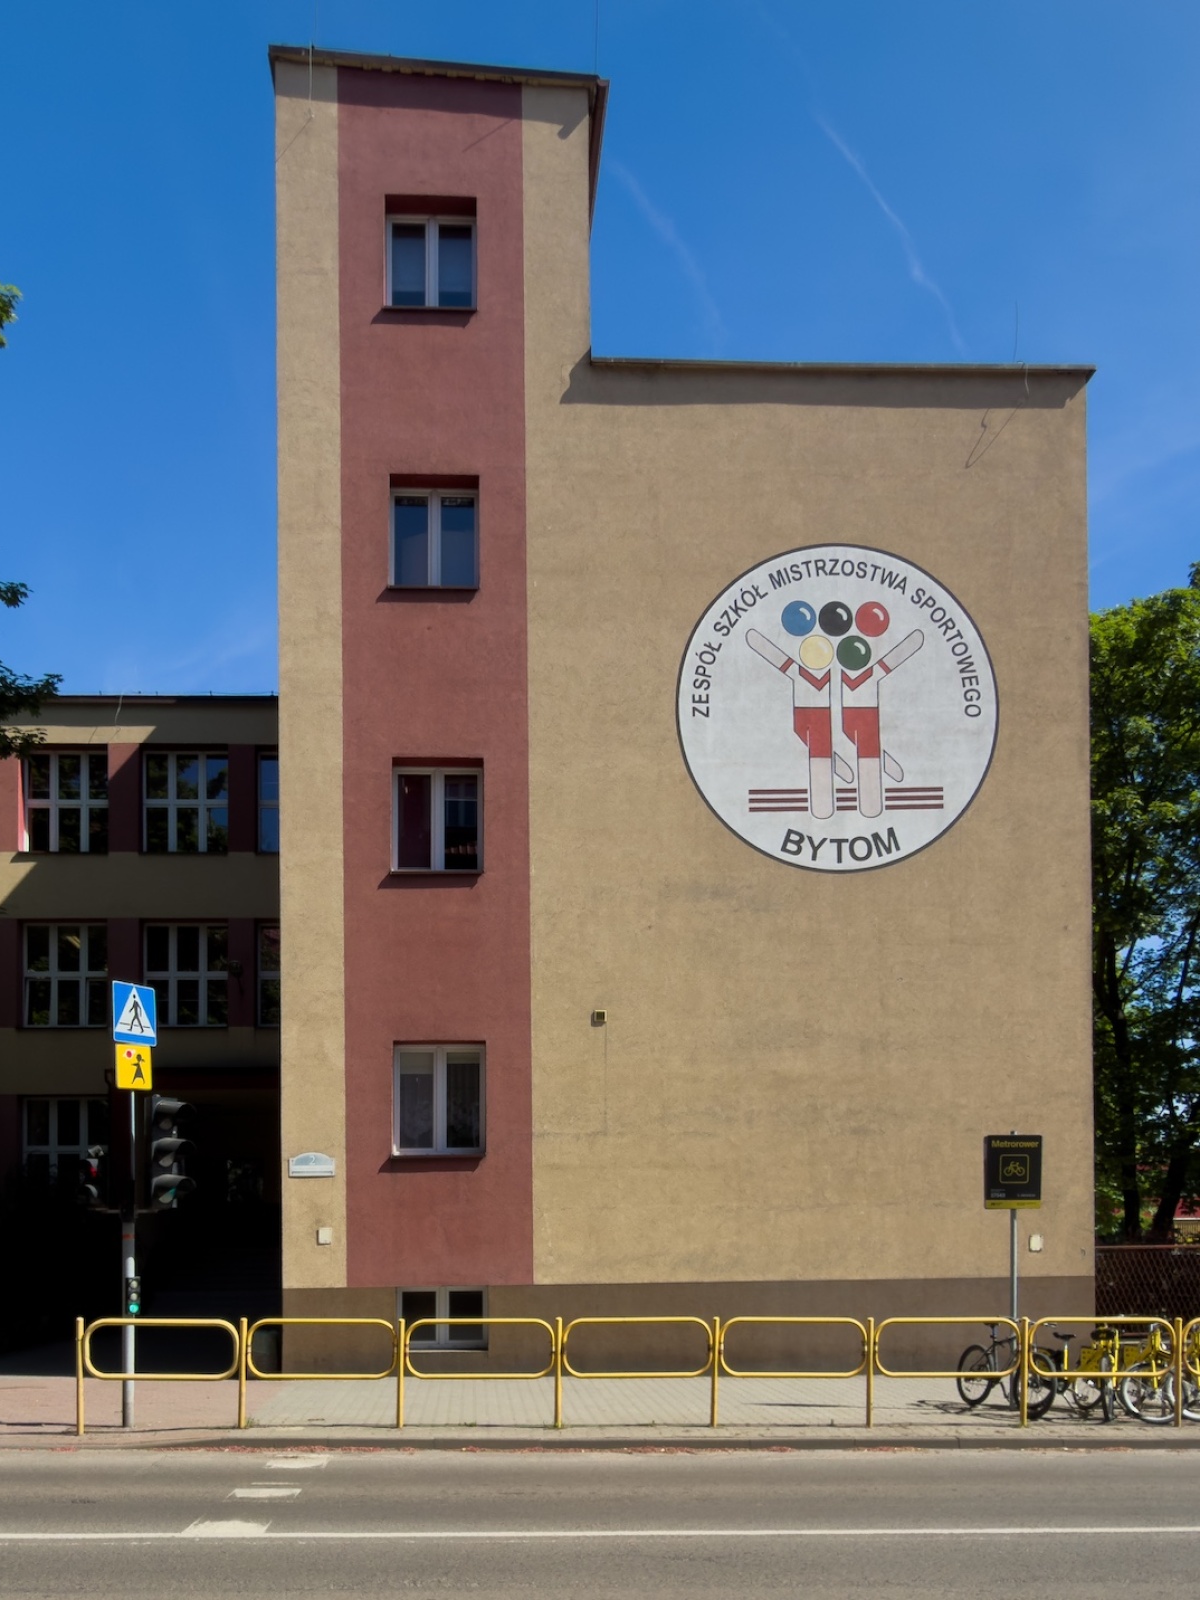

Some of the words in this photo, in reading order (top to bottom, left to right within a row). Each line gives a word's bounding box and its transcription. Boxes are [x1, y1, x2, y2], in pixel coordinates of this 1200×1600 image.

[692, 640, 723, 718] ZESPÓŁ
[713, 584, 769, 637] SZKÓŁ
[768, 558, 908, 596] MISTRZOSTWA
[910, 587, 982, 718] SPORTOWEGO
[780, 826, 901, 864] BYTOM
[991, 1140, 1039, 1148] Metrorower
[309, 1155, 316, 1165] 2
